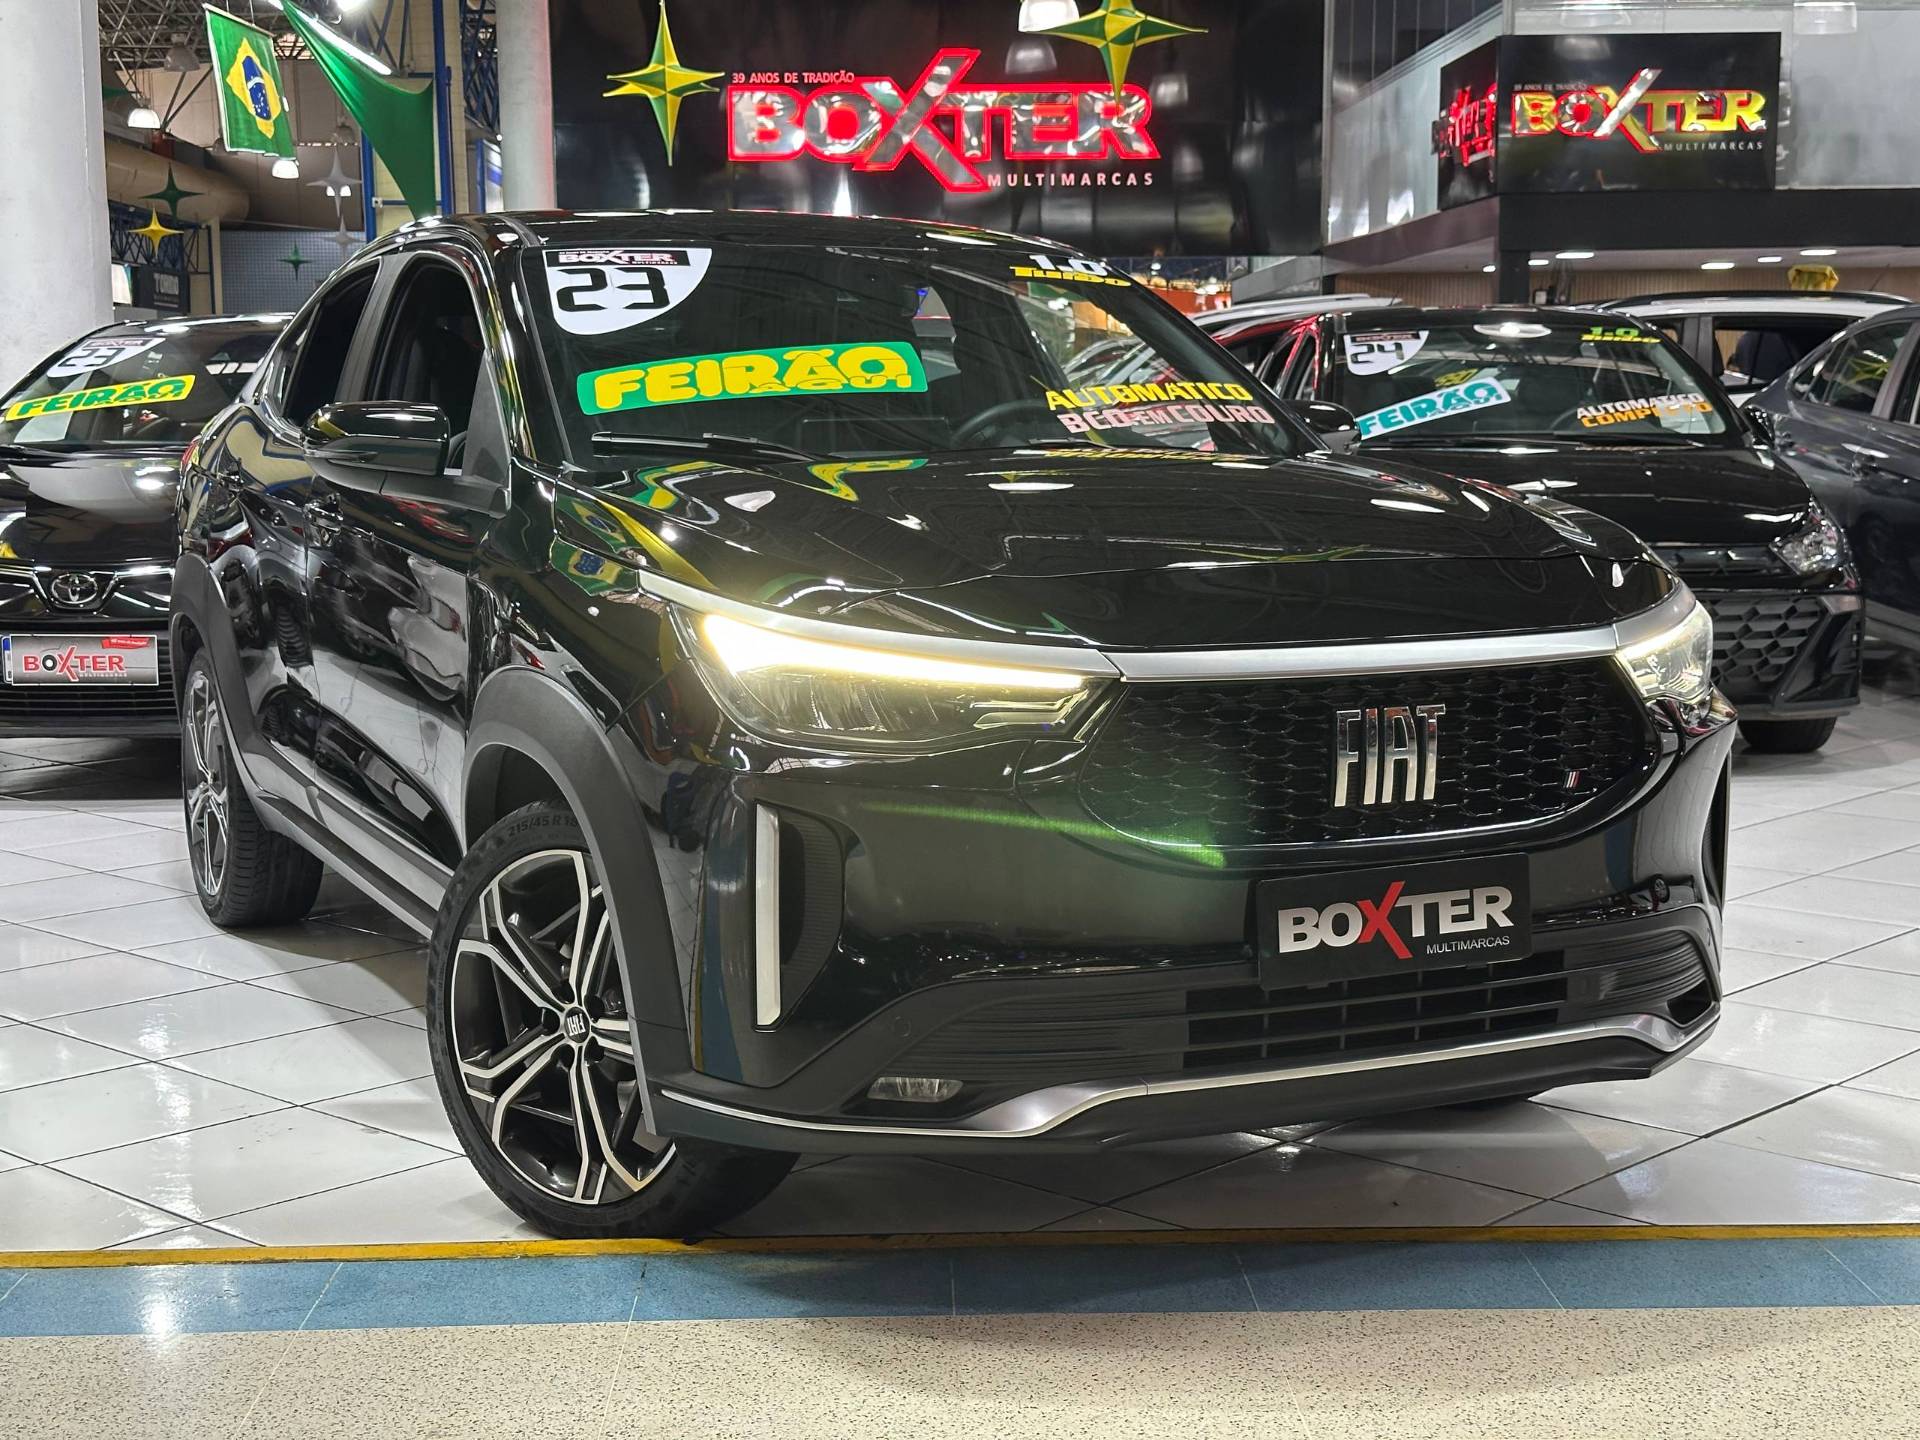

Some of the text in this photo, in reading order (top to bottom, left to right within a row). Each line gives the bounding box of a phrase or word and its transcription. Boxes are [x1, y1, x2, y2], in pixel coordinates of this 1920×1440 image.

[731, 70, 856, 85] 39 ANOS DE TRADIÇÃO
[728, 48, 1161, 192] BOXTER
[1511, 68, 1766, 154] BOXTER
[1663, 140, 1764, 152] MULTIMARCAS
[987, 173, 1154, 187] MULTIMARCAS
[558, 249, 678, 265] BOXTER
[1028, 254, 1108, 277] 1.0
[556, 267, 670, 313] 23
[1590, 327, 1639, 337] 1.0
[57, 347, 126, 368] 23
[1351, 342, 1404, 365] 24
[594, 346, 909, 410] FEIRÃO
[16, 379, 187, 416] FEIRÃO
[1356, 382, 1499, 436] FEIRÃO
[1168, 403, 1276, 425] COURO
[23, 645, 126, 682] BOXTER
[1334, 704, 1446, 807] FIAT
[1278, 881, 1515, 960] BOXTER
[1426, 935, 1511, 955] MULTIMARCAS
[566, 1013, 587, 1037] FIAT
